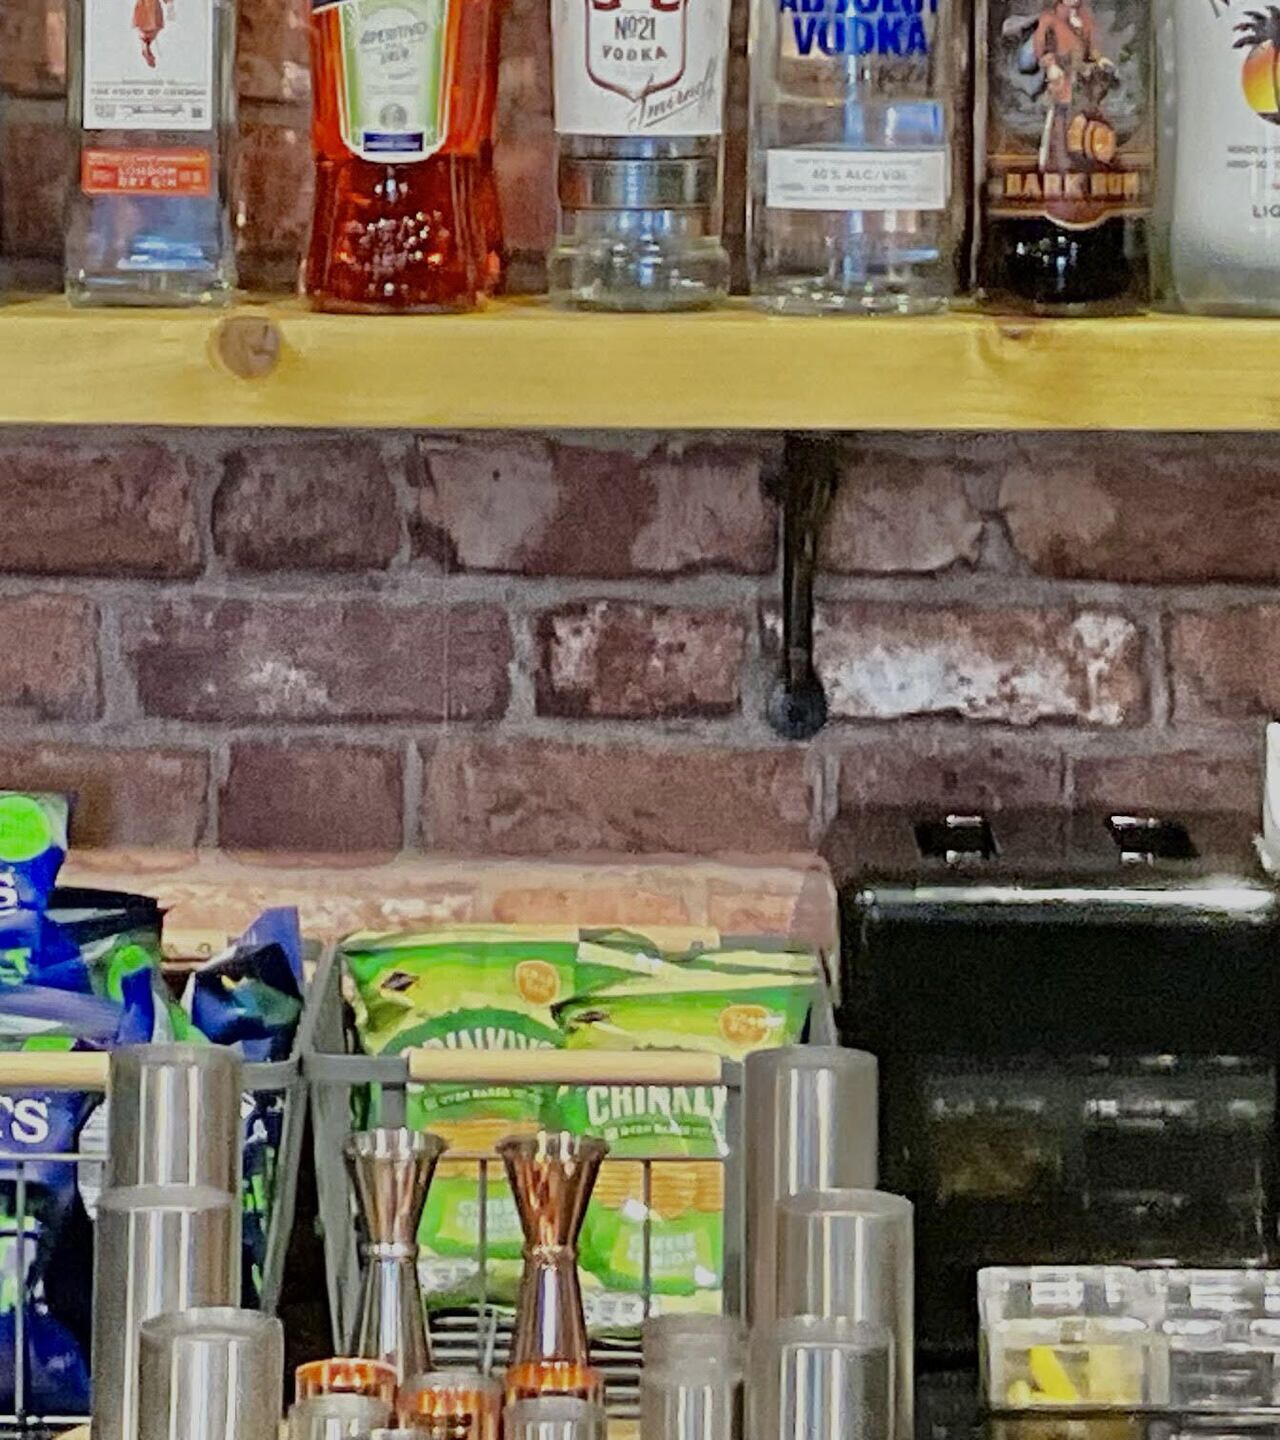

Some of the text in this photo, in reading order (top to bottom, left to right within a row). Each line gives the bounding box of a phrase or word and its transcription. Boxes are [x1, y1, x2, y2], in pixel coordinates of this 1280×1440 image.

[792, 15, 929, 56] VODKA
[601, 45, 669, 62] VODKA
[1006, 172, 1141, 199] DARK RUM
